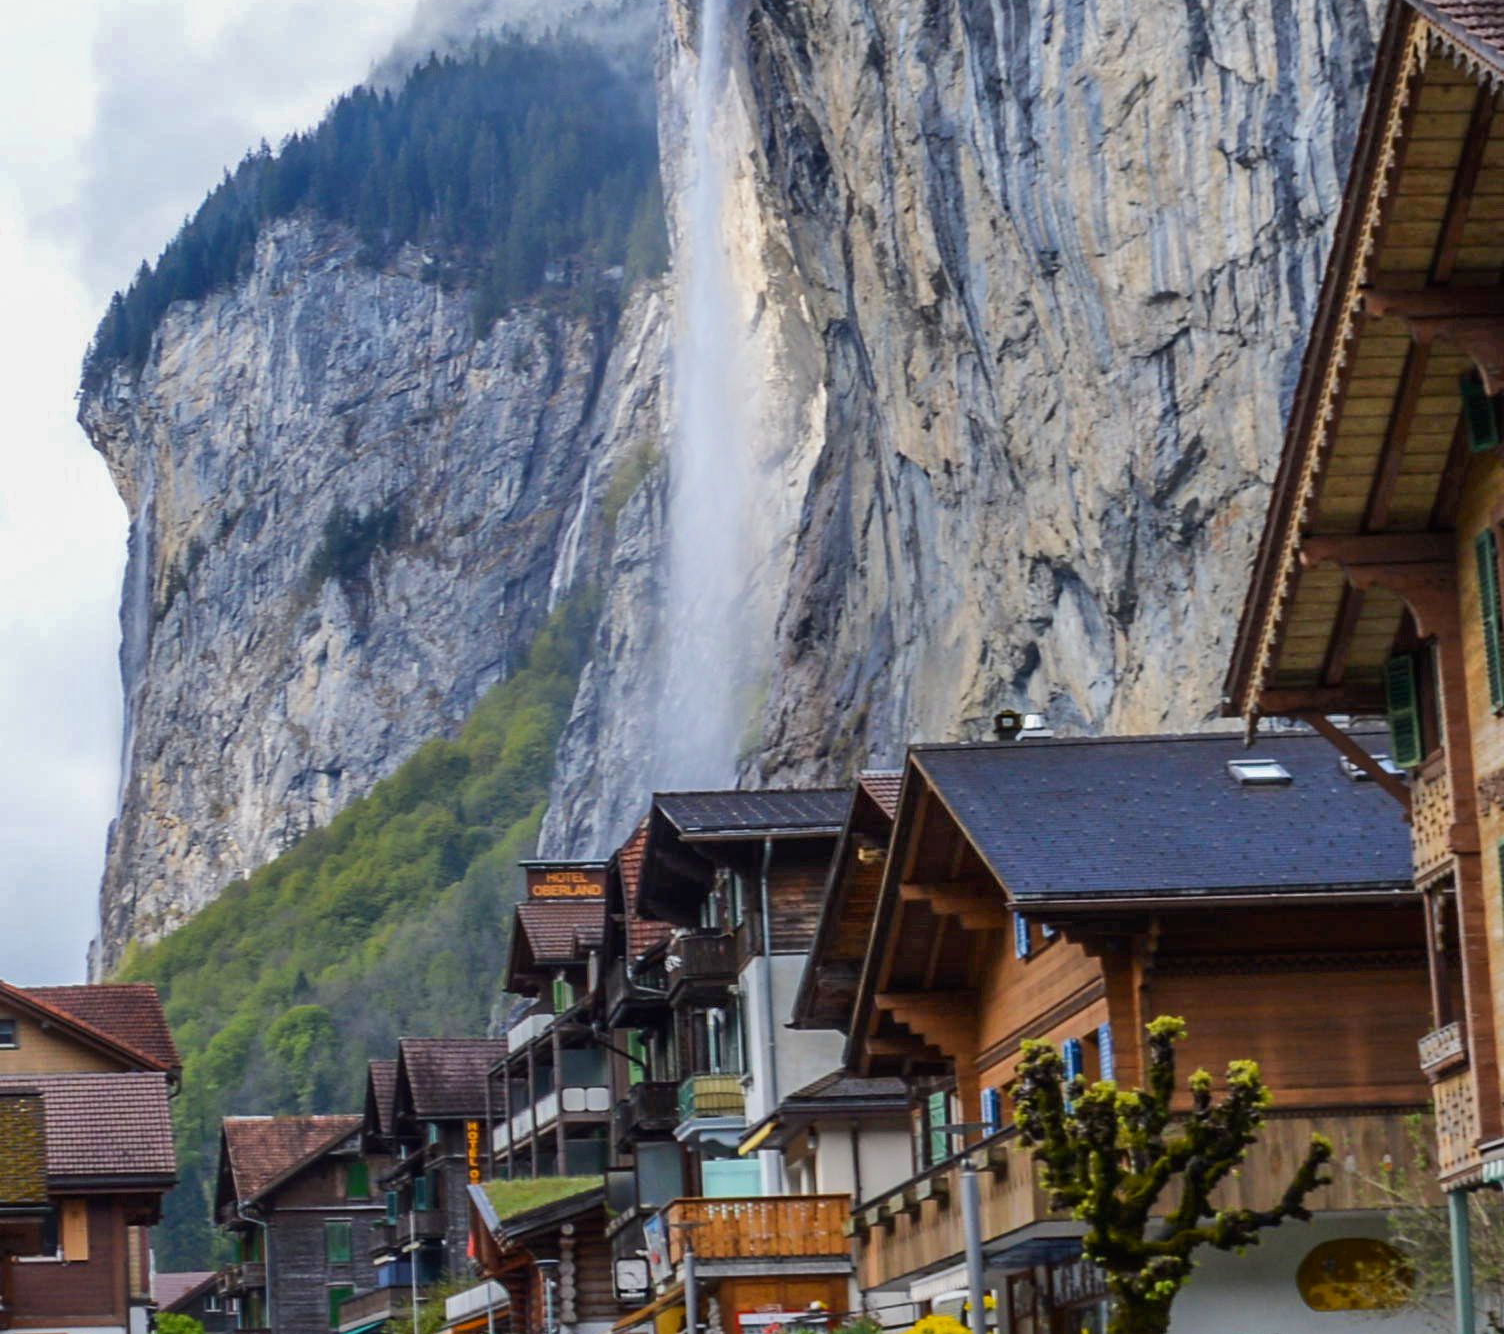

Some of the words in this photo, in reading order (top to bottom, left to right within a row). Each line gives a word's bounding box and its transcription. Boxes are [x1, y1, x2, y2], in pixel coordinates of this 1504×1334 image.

[545, 871, 589, 883] HOTEL
[532, 884, 603, 897] OBERLAND
[466, 1121, 480, 1167] HOTEL
